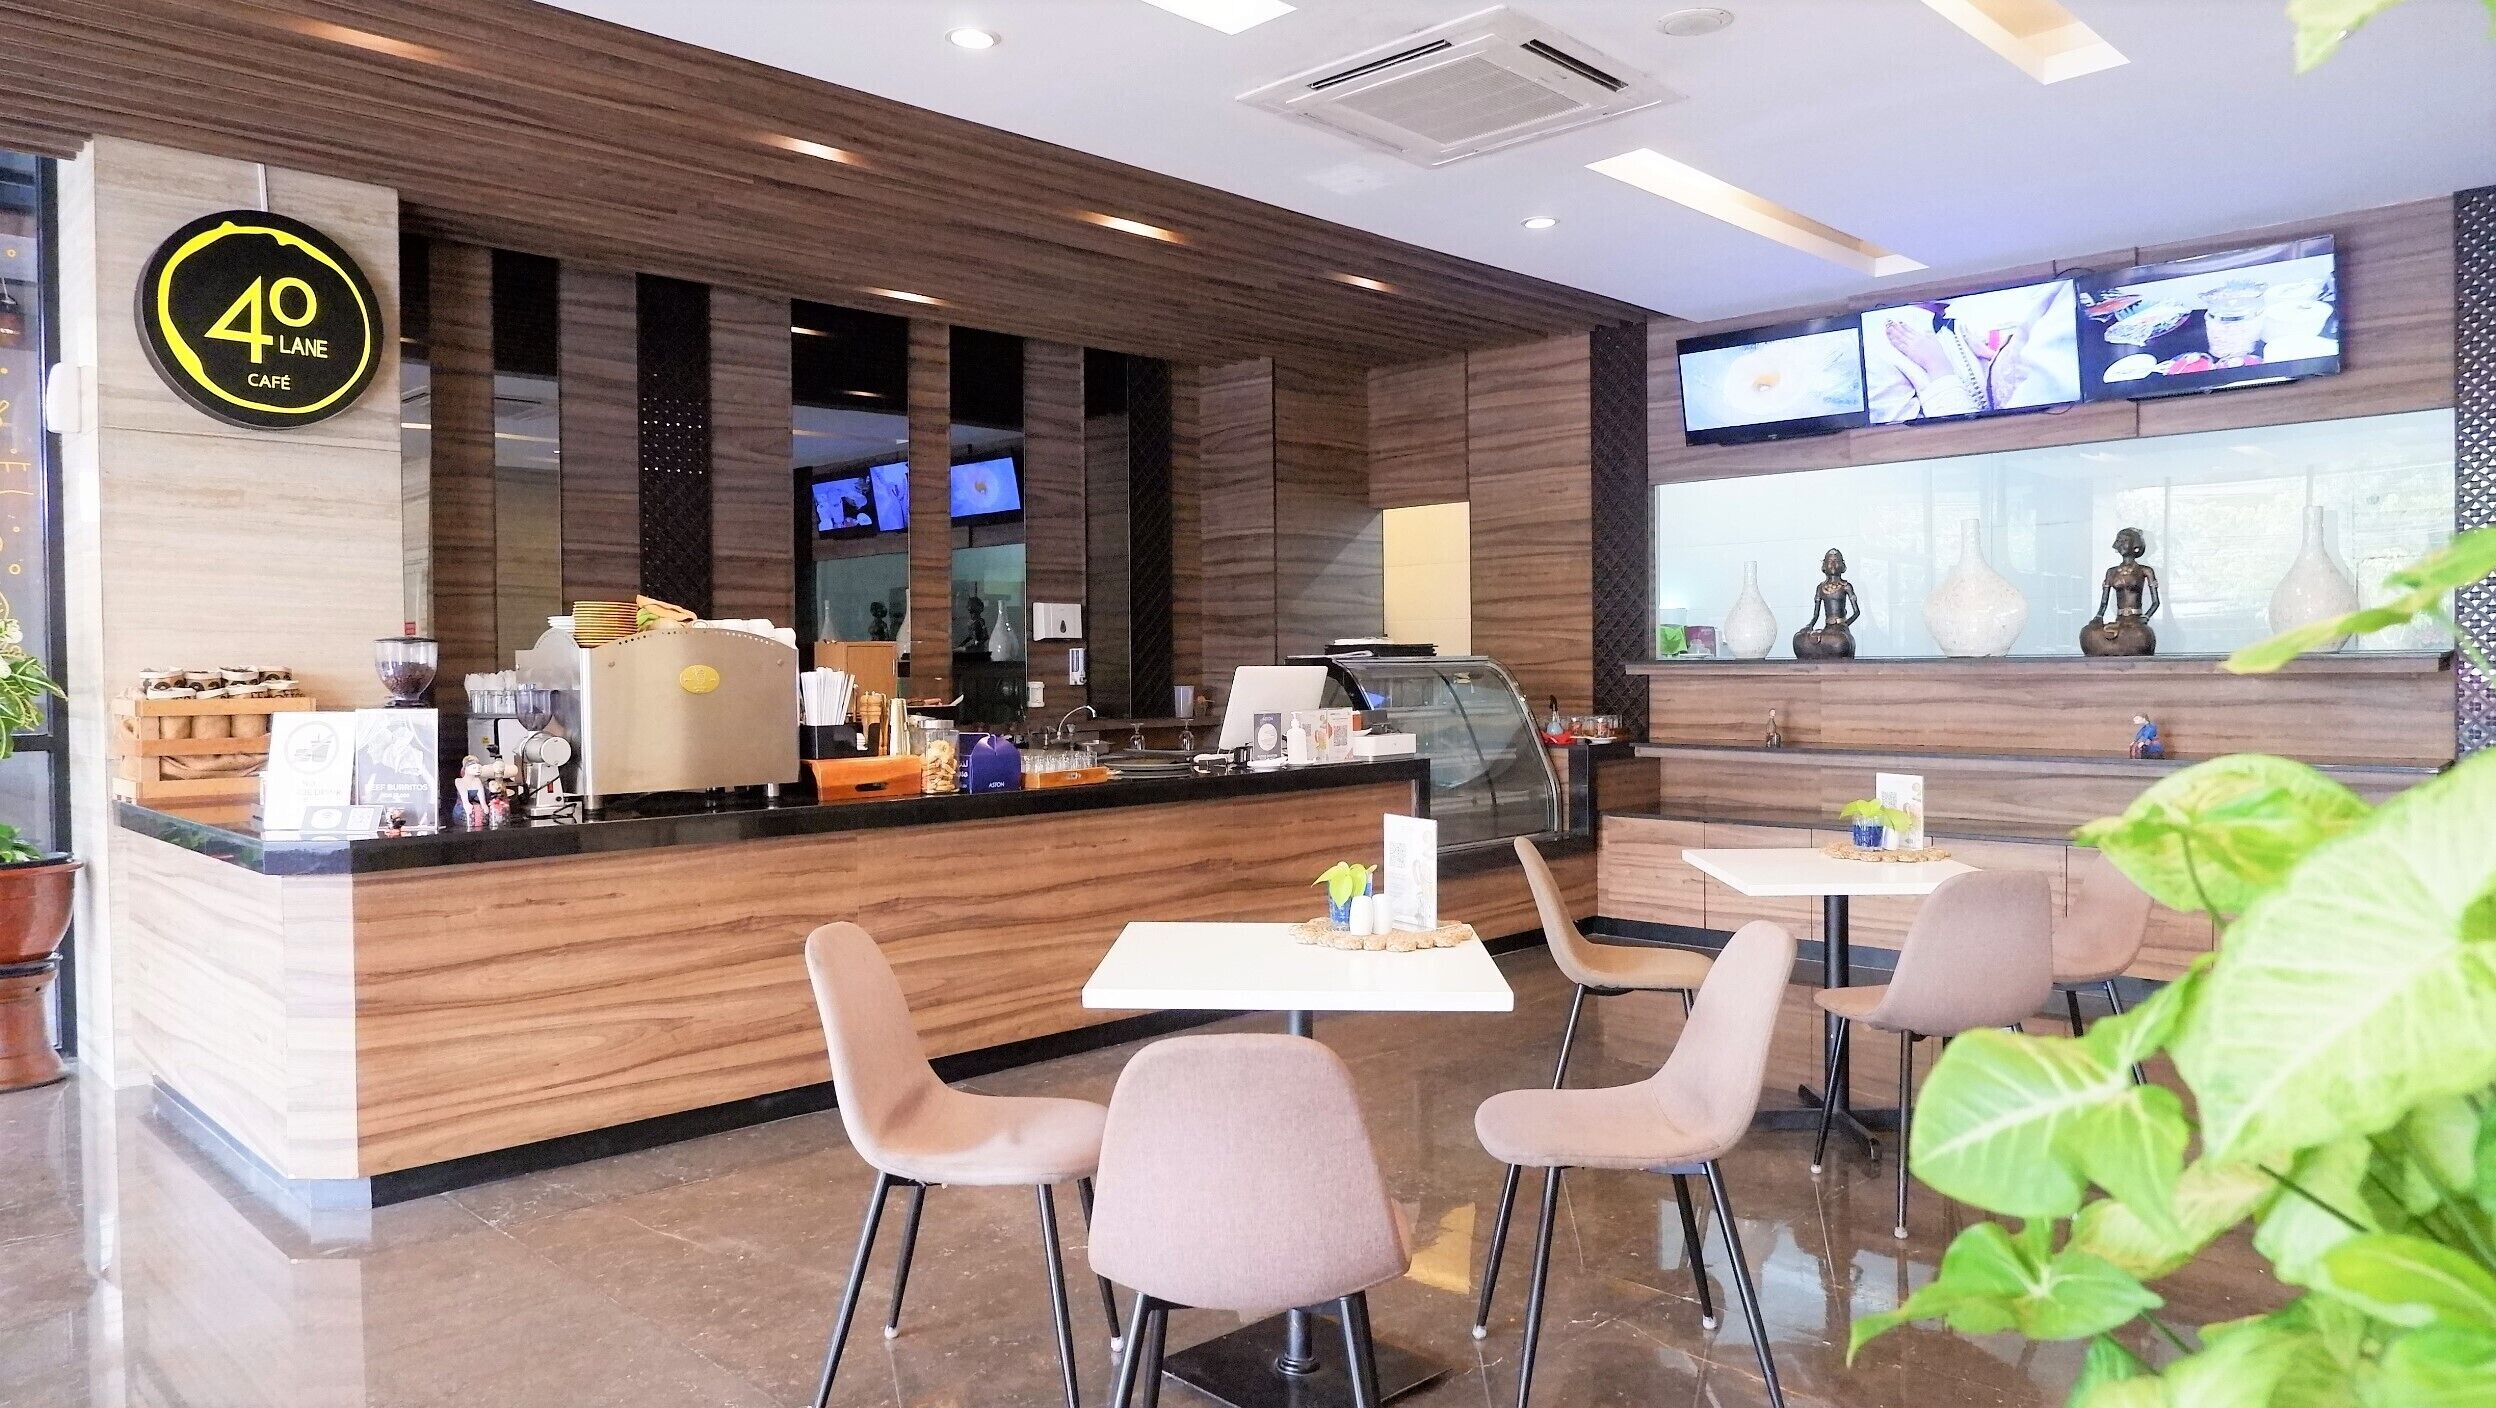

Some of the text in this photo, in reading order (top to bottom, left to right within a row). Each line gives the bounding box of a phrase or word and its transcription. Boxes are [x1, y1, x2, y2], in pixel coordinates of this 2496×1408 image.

[279, 334, 328, 358] LANE
[247, 373, 291, 390] CAFÉ
[386, 783, 428, 791] BURRITOS
